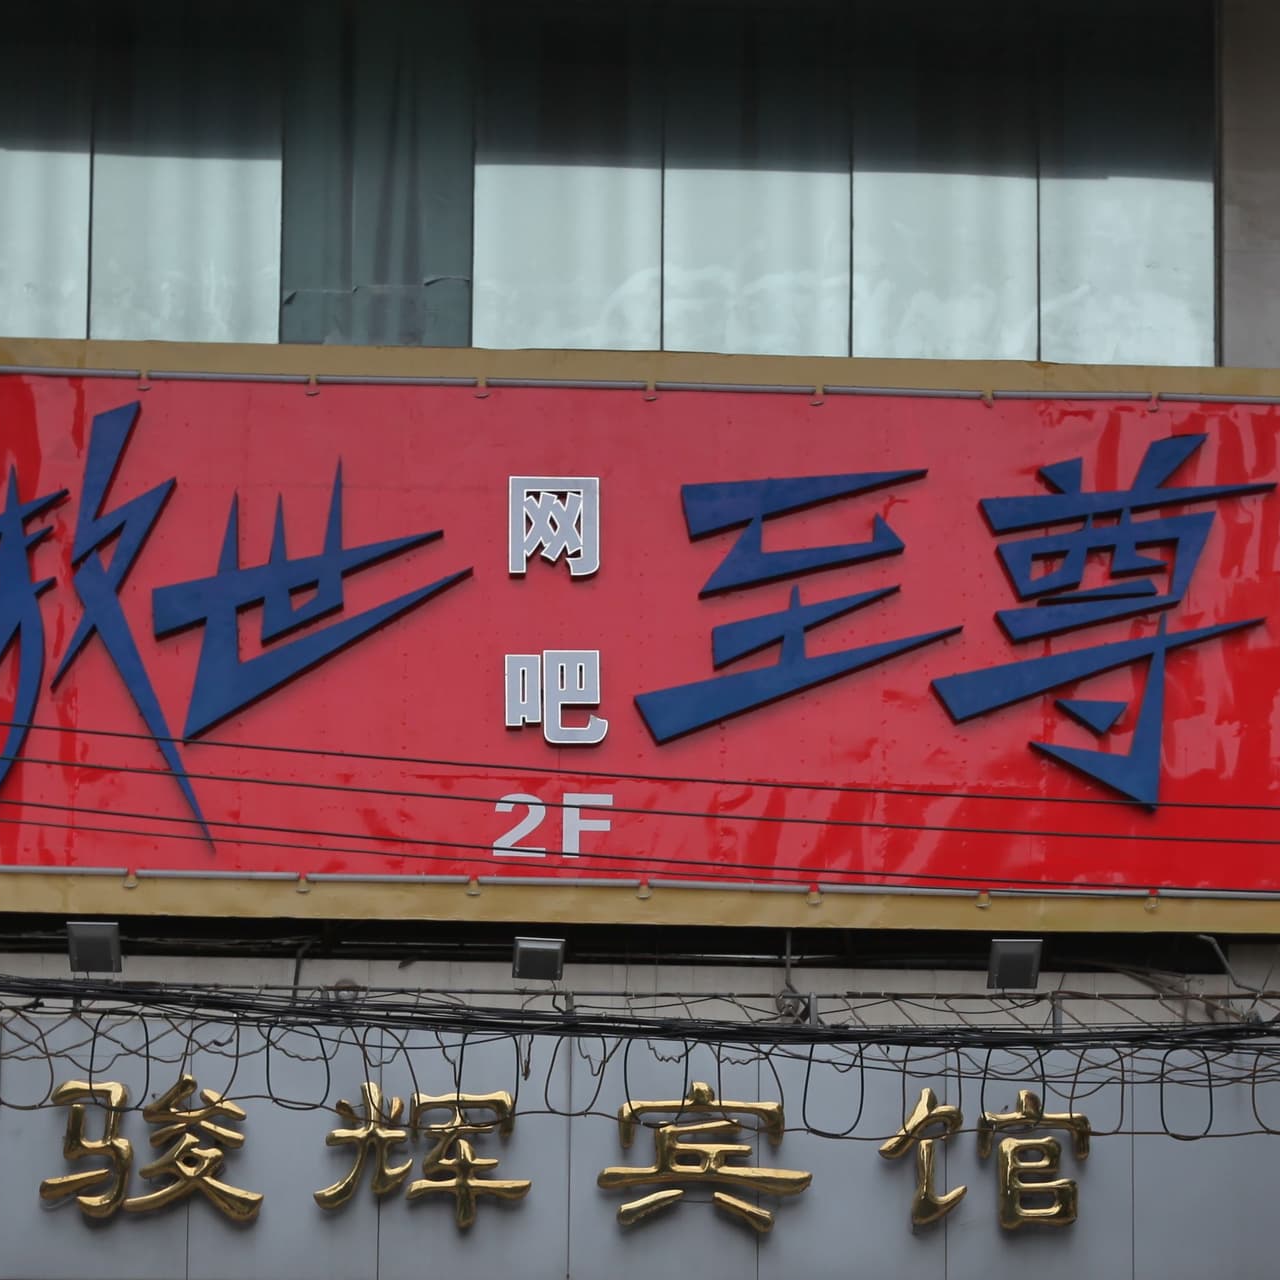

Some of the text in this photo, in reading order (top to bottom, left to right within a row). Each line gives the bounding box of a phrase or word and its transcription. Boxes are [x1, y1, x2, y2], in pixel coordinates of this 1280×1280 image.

[504, 477, 609, 744] 网吧
[634, 432, 1278, 813] 至尊
[492, 794, 613, 858] 2F
[40, 1075, 1090, 1233] 骏辉宾馆
